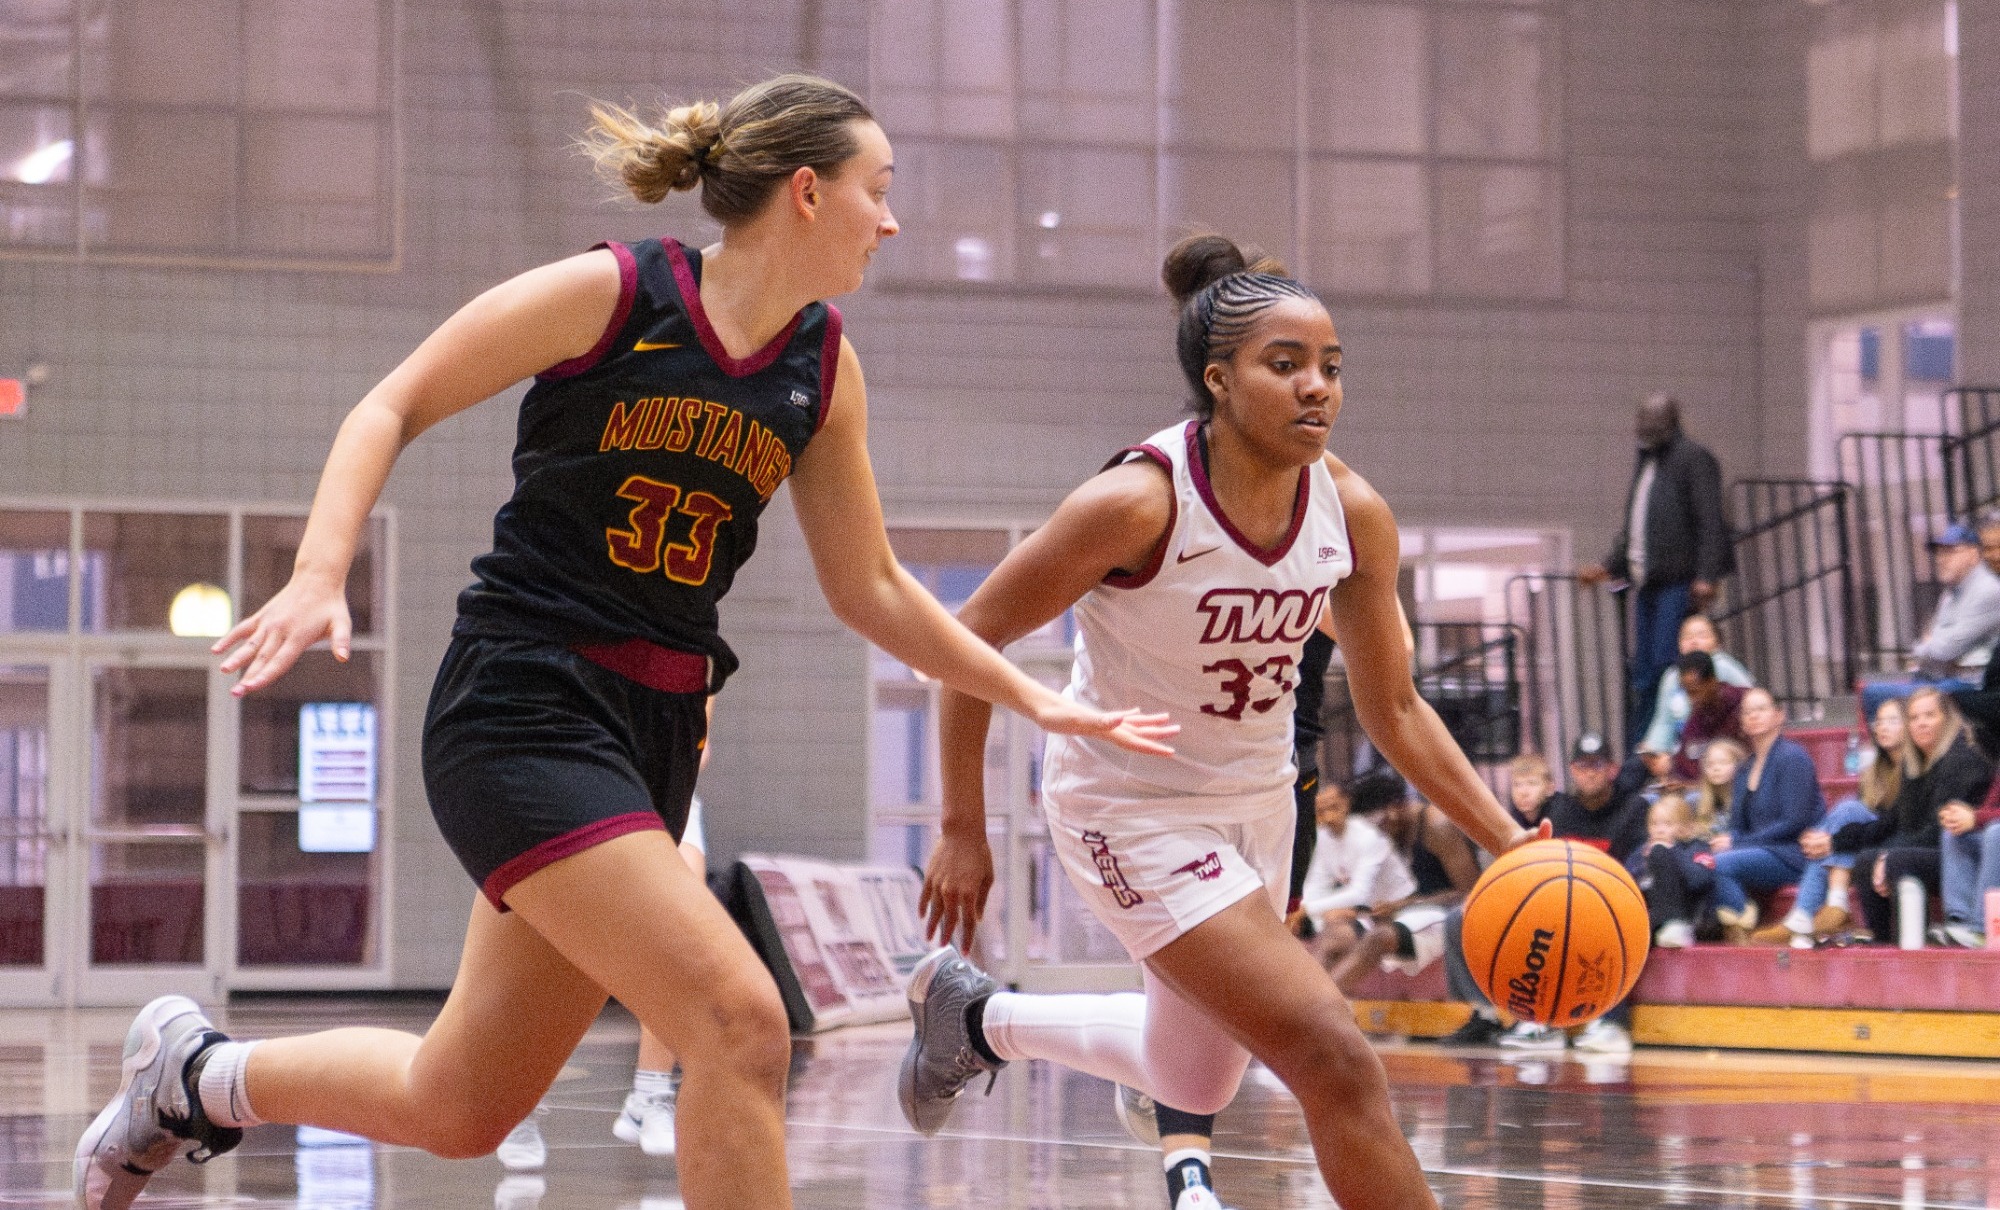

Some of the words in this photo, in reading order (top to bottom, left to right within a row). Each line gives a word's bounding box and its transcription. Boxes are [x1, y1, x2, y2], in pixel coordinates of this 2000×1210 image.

[606, 475, 732, 585] 33
[1196, 586, 1329, 644] TWU
[1200, 655, 1293, 721] 33
[1194, 855, 1220, 880] TWU
